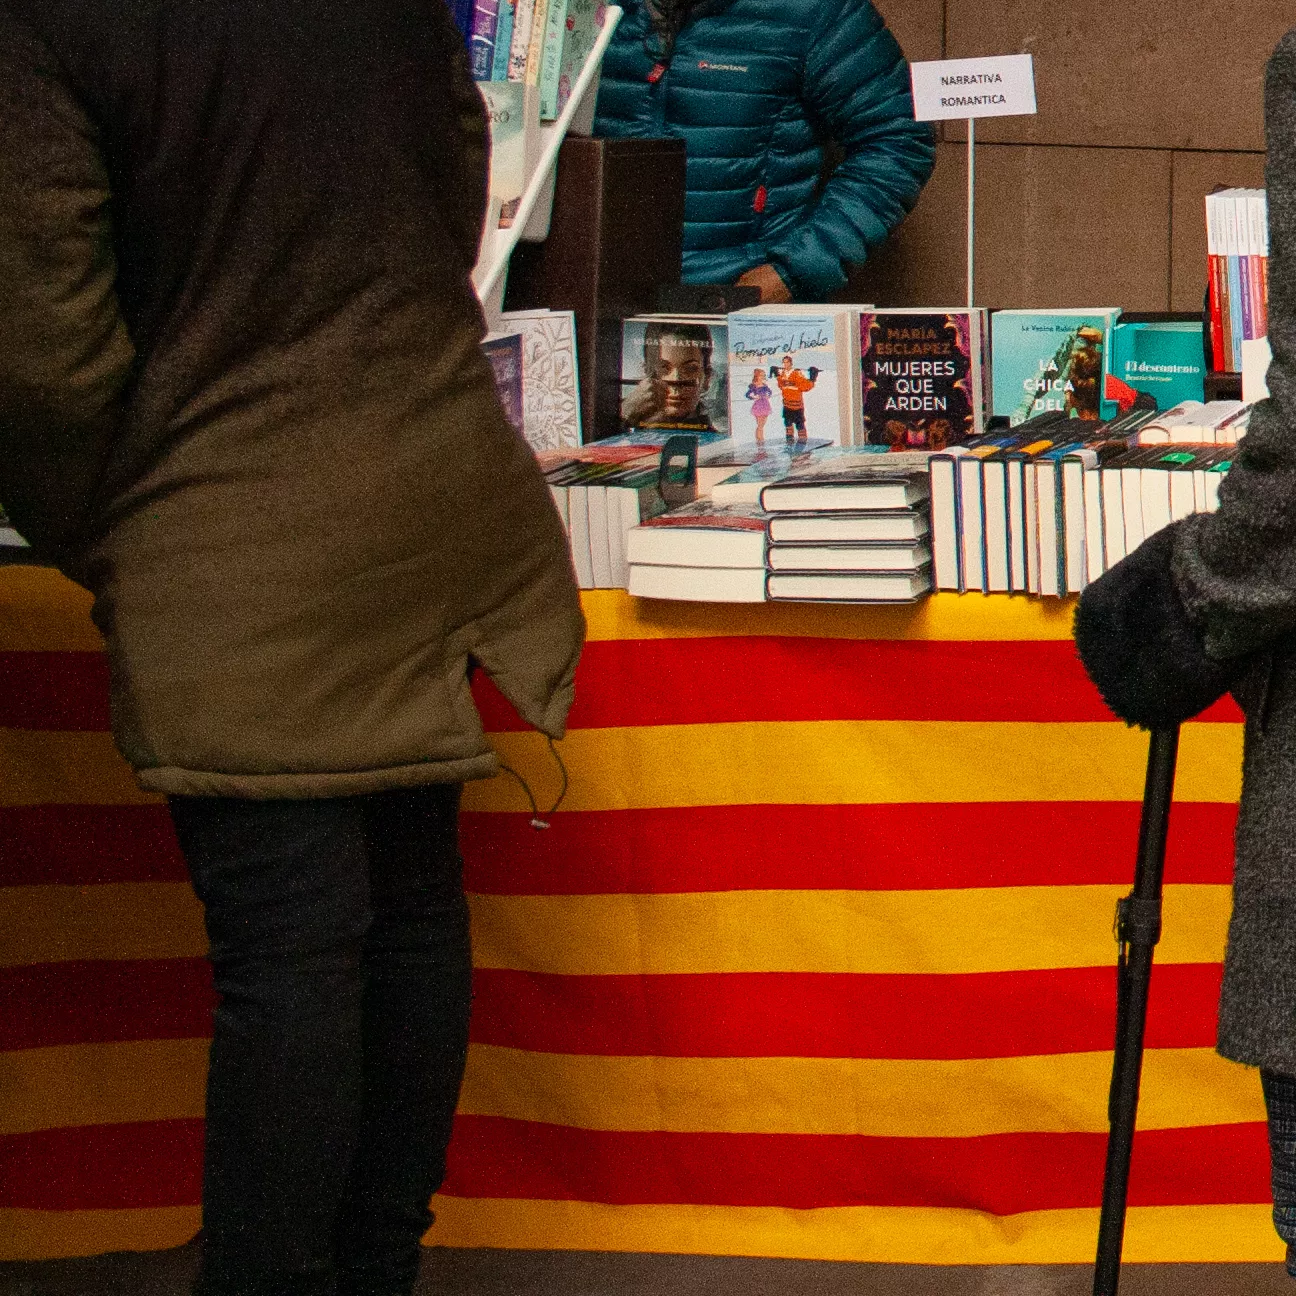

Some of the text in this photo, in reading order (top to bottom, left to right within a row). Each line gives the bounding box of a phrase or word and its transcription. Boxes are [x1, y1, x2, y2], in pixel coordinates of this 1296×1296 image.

[940, 72, 1003, 87] NARRATIVA
[940, 93, 1007, 108] ROMANTICA
[800, 329, 829, 350] hielo
[875, 361, 955, 376] MUJERES
[1039, 359, 1059, 372] LA
[895, 379, 934, 394] QUE
[1022, 378, 1075, 392] CHICA
[885, 396, 947, 411] ARDEN
[1034, 398, 1065, 412] DEL
